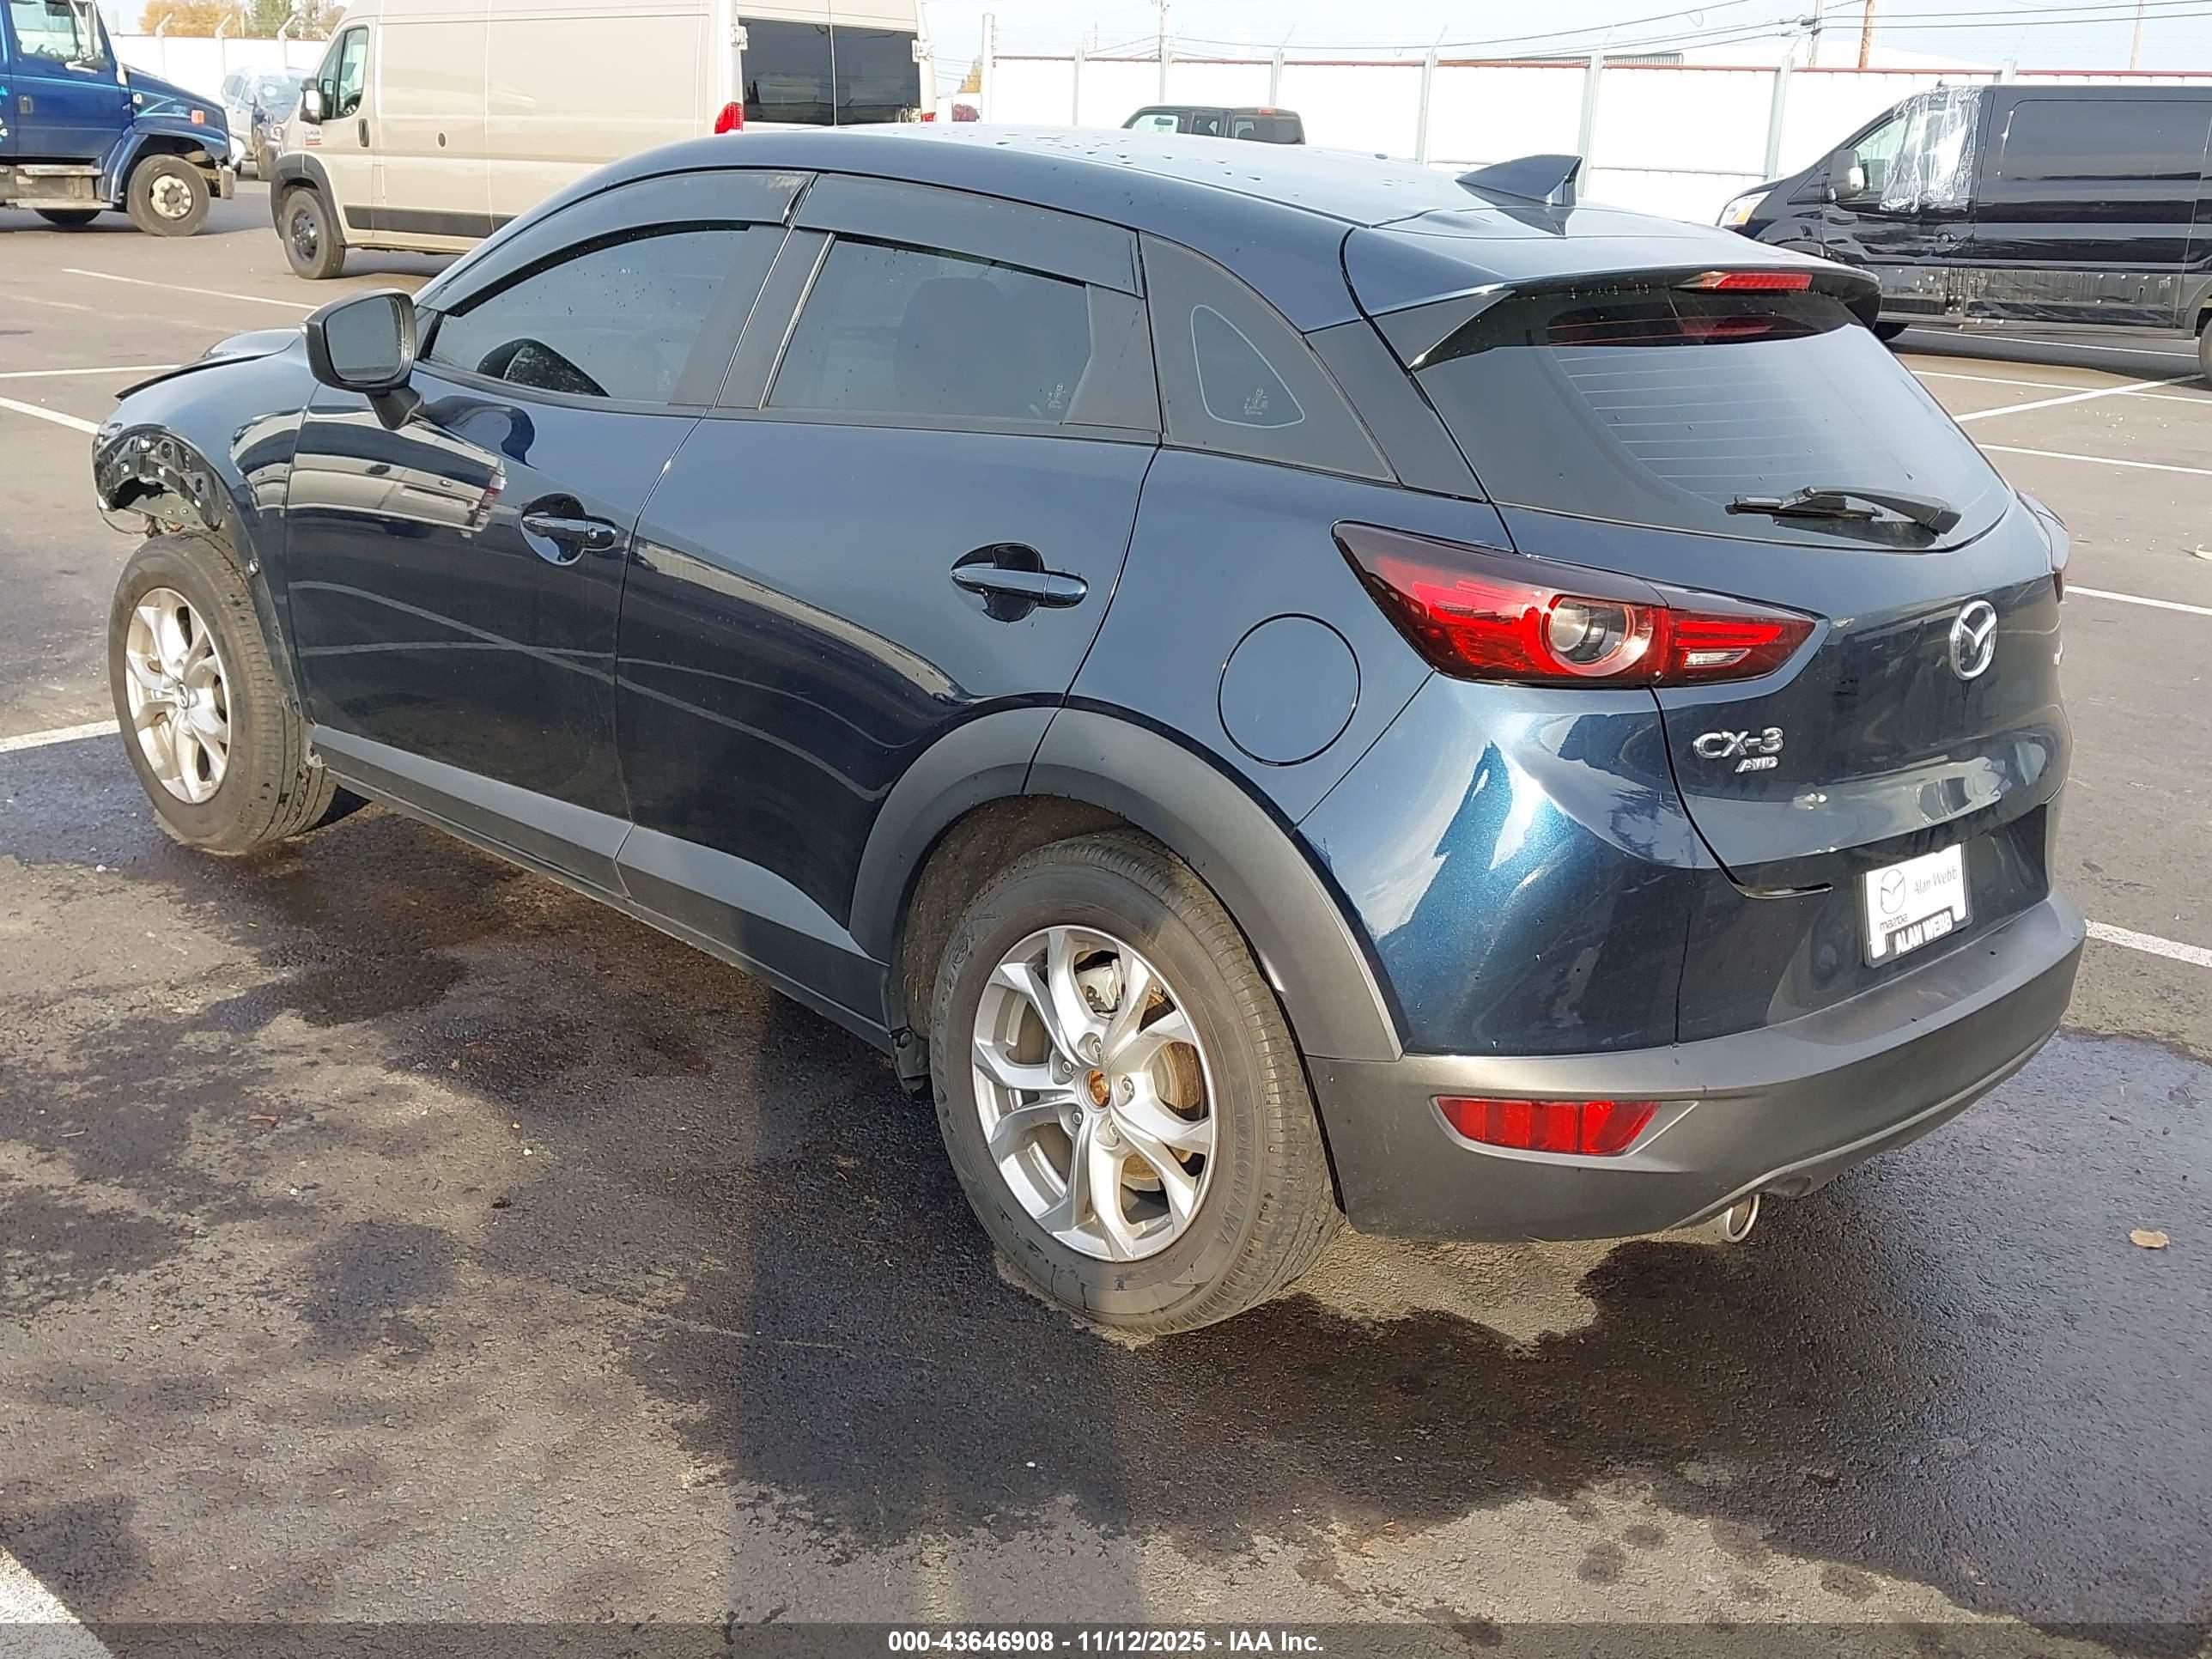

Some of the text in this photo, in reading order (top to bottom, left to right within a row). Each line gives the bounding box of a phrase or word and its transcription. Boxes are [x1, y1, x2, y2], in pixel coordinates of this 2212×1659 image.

[1692, 726, 1784, 759] CX-3
[1735, 756, 1779, 773] AWD
[1913, 865, 1959, 895] Alan Webb
[1894, 909, 1954, 956] ALAN WEBB
[1215, 1114, 1252, 1245] YOKOHAMA
